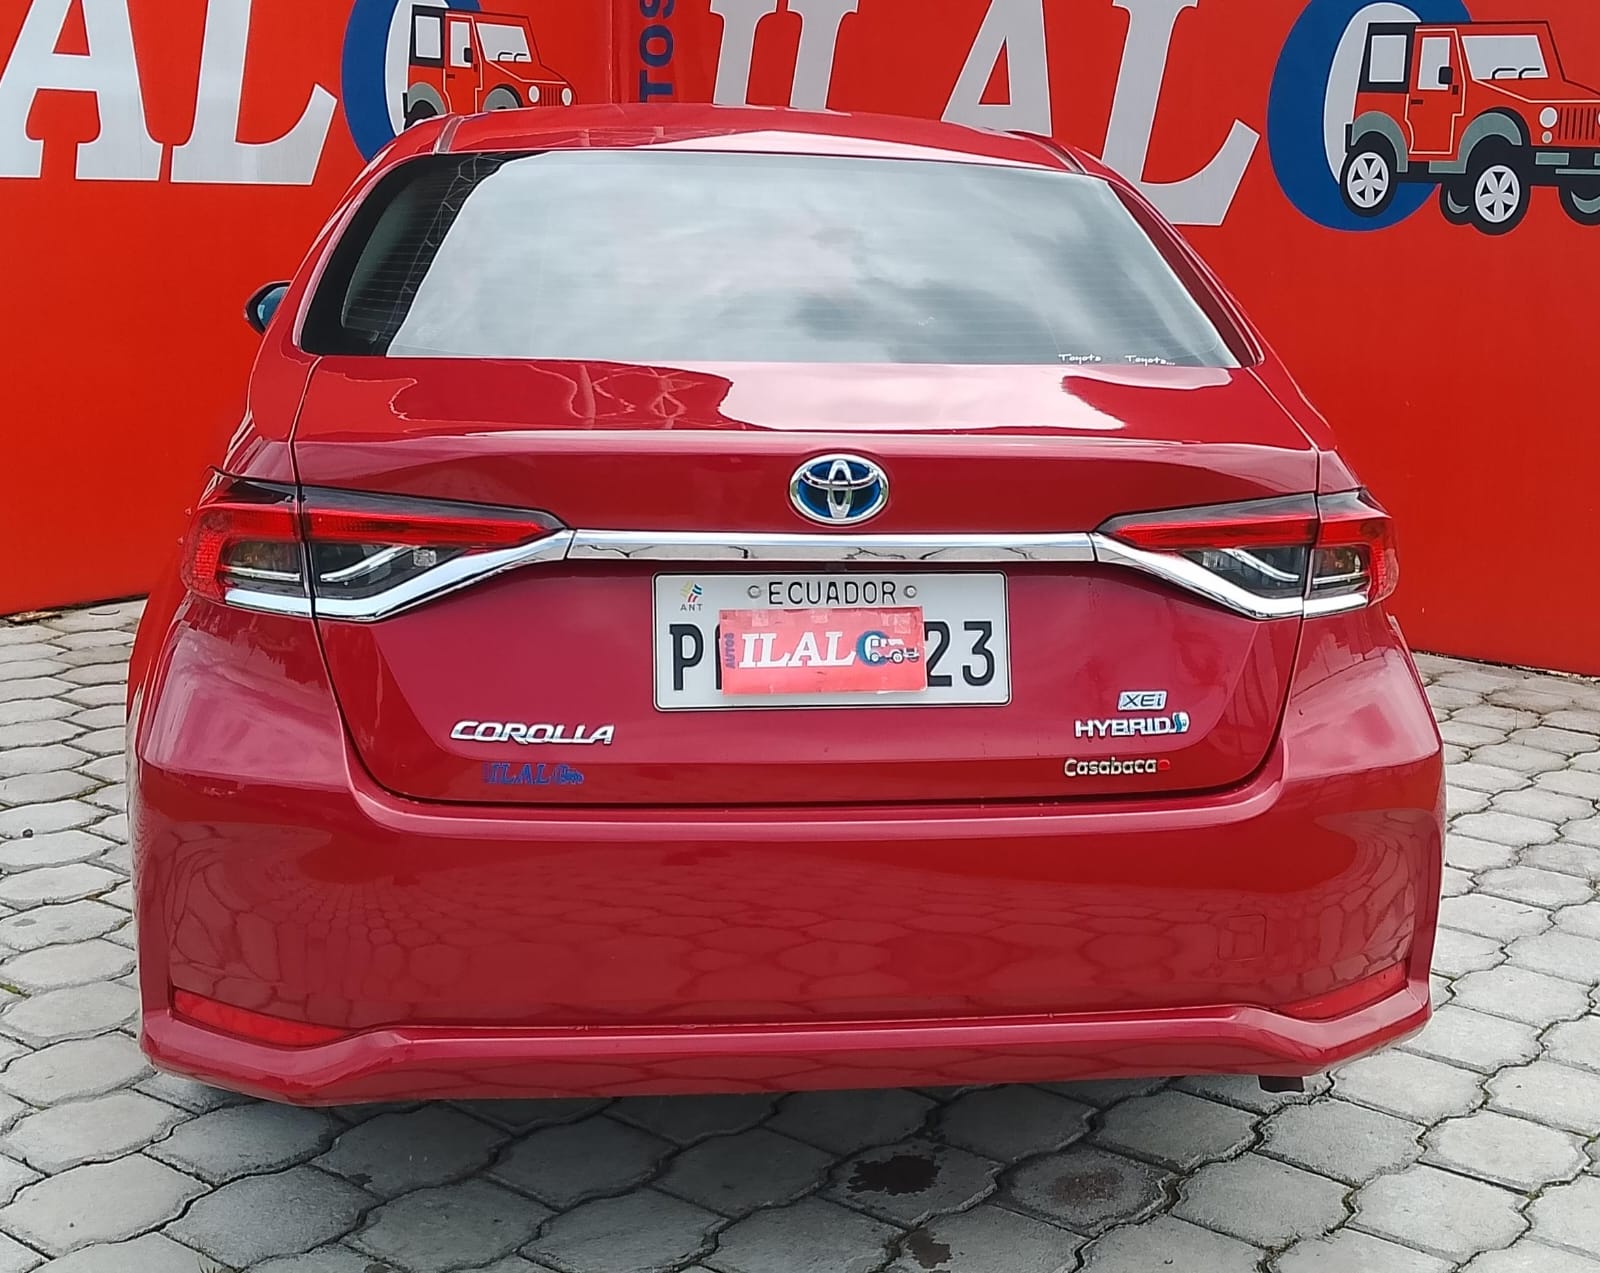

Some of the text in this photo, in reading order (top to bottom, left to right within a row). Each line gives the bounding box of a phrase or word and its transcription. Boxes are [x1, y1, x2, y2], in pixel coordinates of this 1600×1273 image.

[1058, 353, 1102, 365] Toyota
[768, 580, 897, 605] ECUADOR
[680, 604, 703, 612] ANT
[1122, 693, 1162, 707] XEi
[451, 720, 615, 746] COROLLA
[1075, 716, 1172, 738] HYBRID
[1064, 757, 1157, 777] Casabaca
